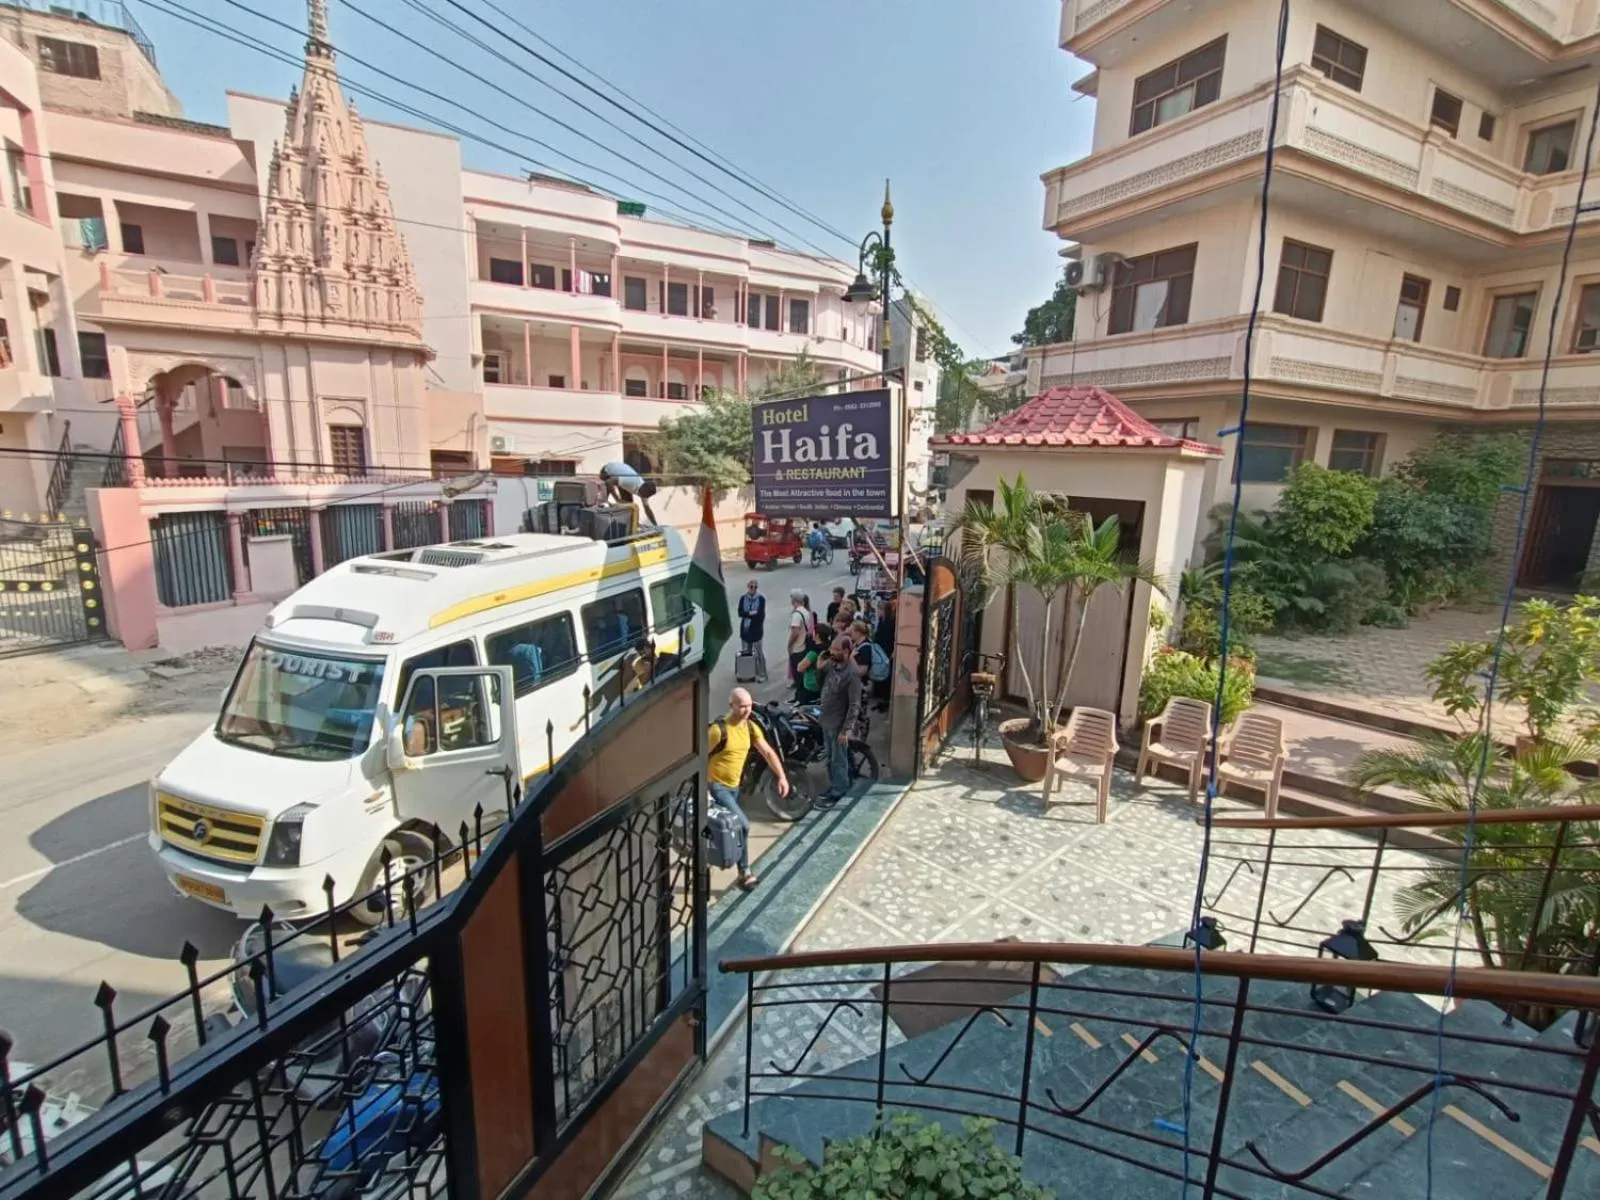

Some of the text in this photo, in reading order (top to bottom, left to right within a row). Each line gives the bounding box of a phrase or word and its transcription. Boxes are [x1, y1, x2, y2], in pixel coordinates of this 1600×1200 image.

[762, 404, 808, 425] Hotel
[762, 423, 880, 464] Haifa
[786, 467, 867, 480] RESTAURANT
[760, 489, 772, 497] The
[790, 488, 824, 497] Attractive
[843, 488, 851, 496] in
[852, 488, 865, 496] the
[866, 488, 886, 497] town
[258, 651, 366, 684] OURIST
